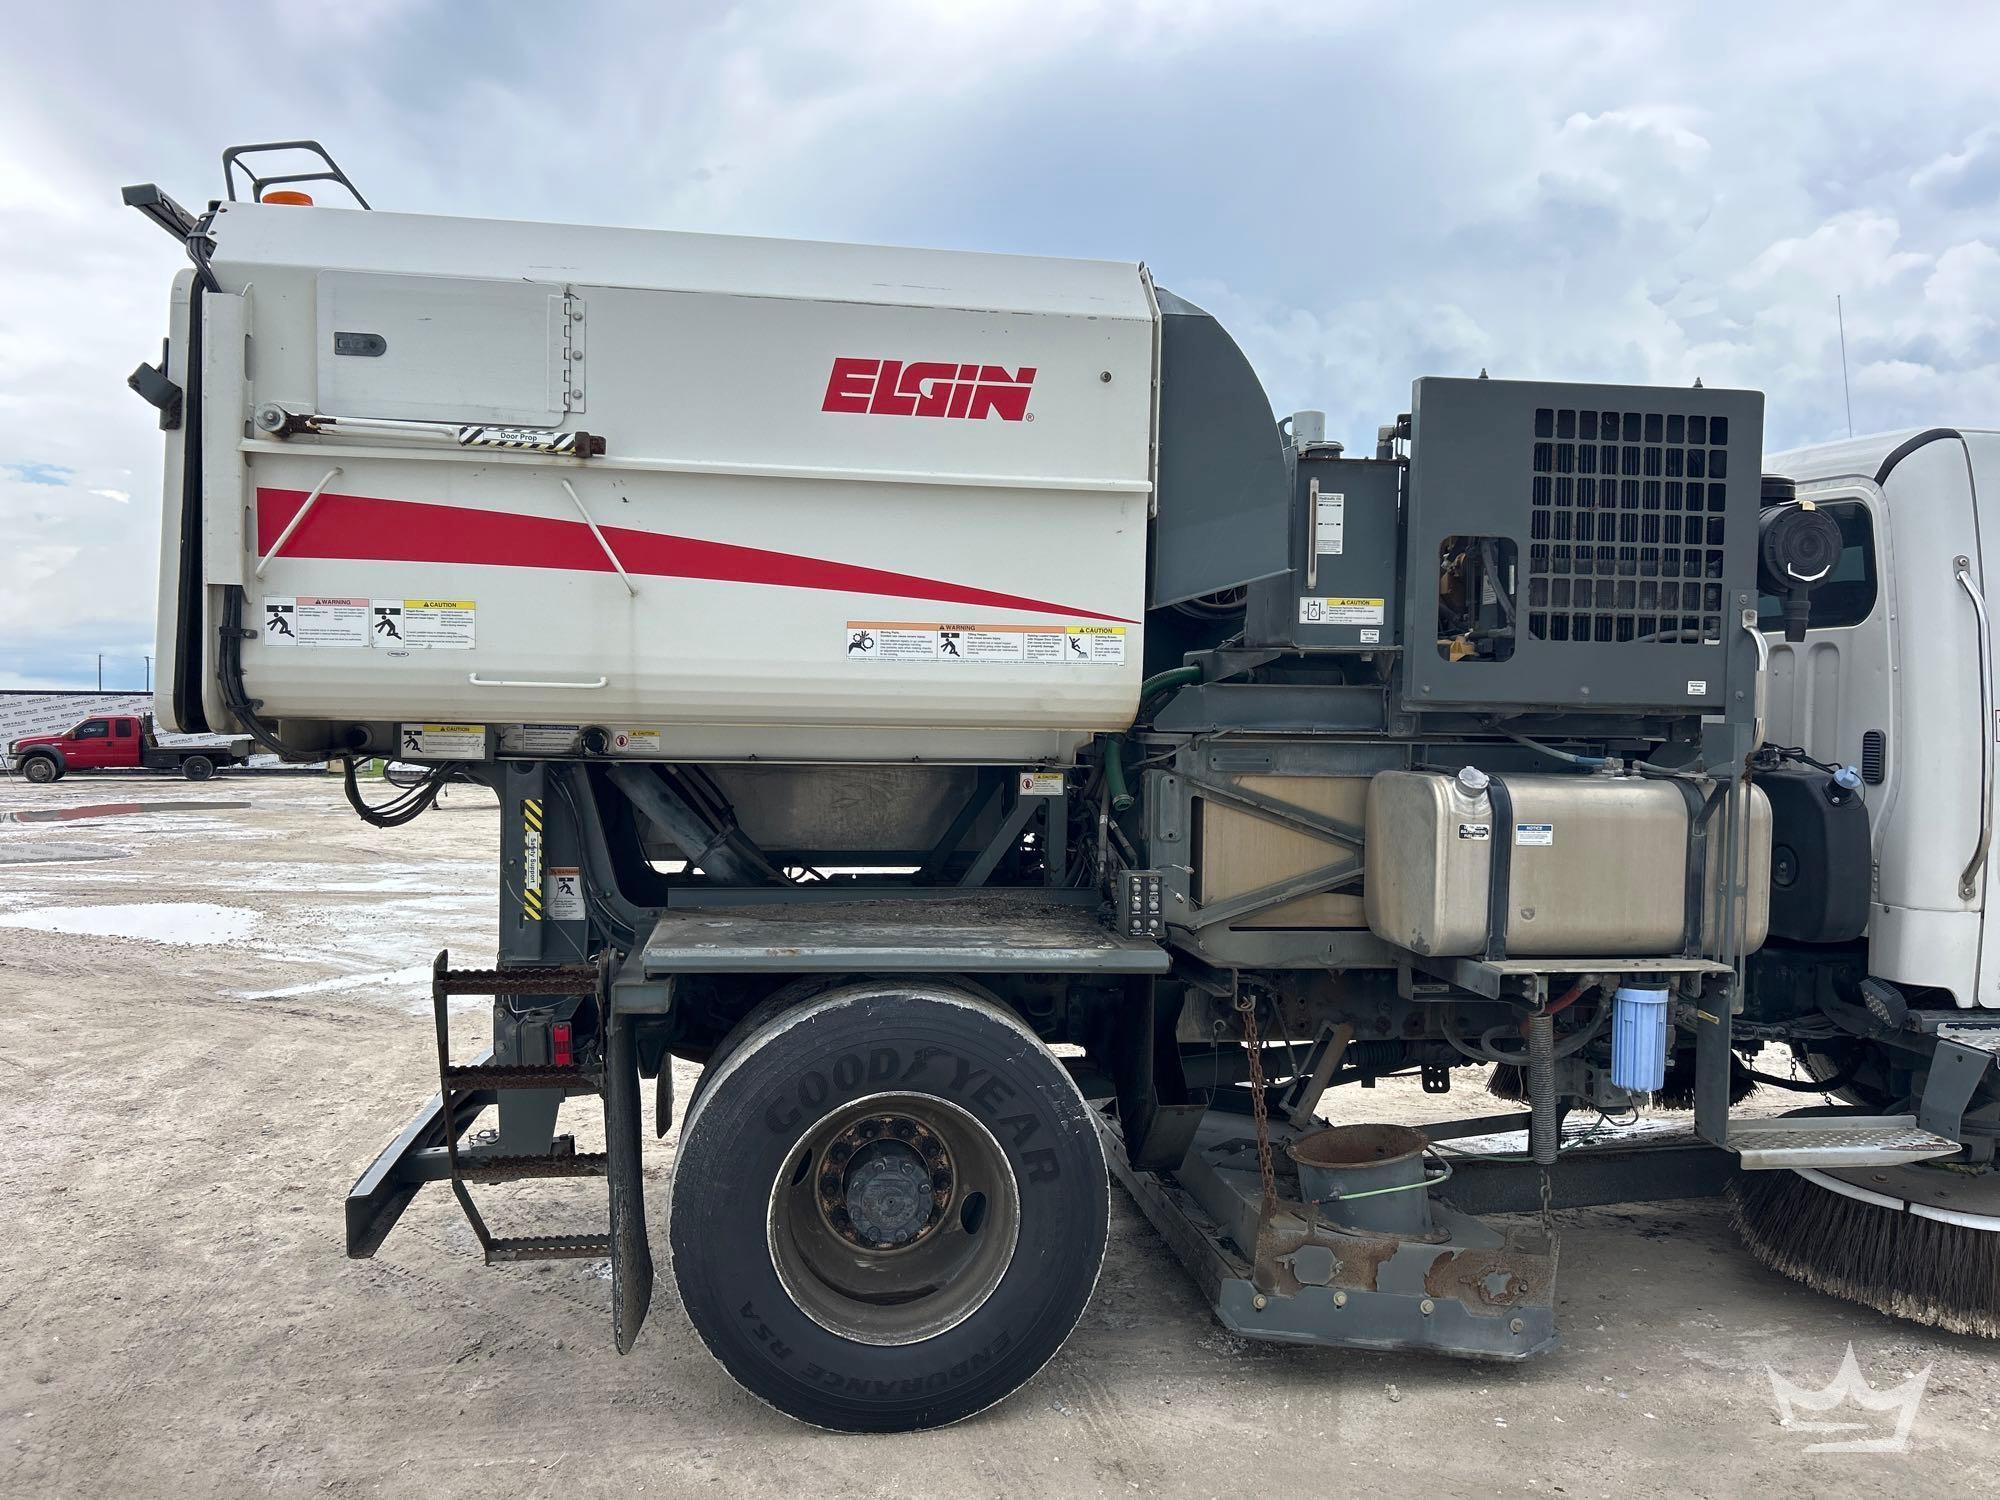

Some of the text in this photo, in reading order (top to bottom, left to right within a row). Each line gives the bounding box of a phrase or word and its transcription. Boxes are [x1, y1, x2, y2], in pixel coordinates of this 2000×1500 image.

[821, 357, 1038, 421] ELGIN
[520, 434, 538, 442] Prop
[739, 1300, 793, 1361] RSA
[800, 1329, 1014, 1396] ENDURANCE
